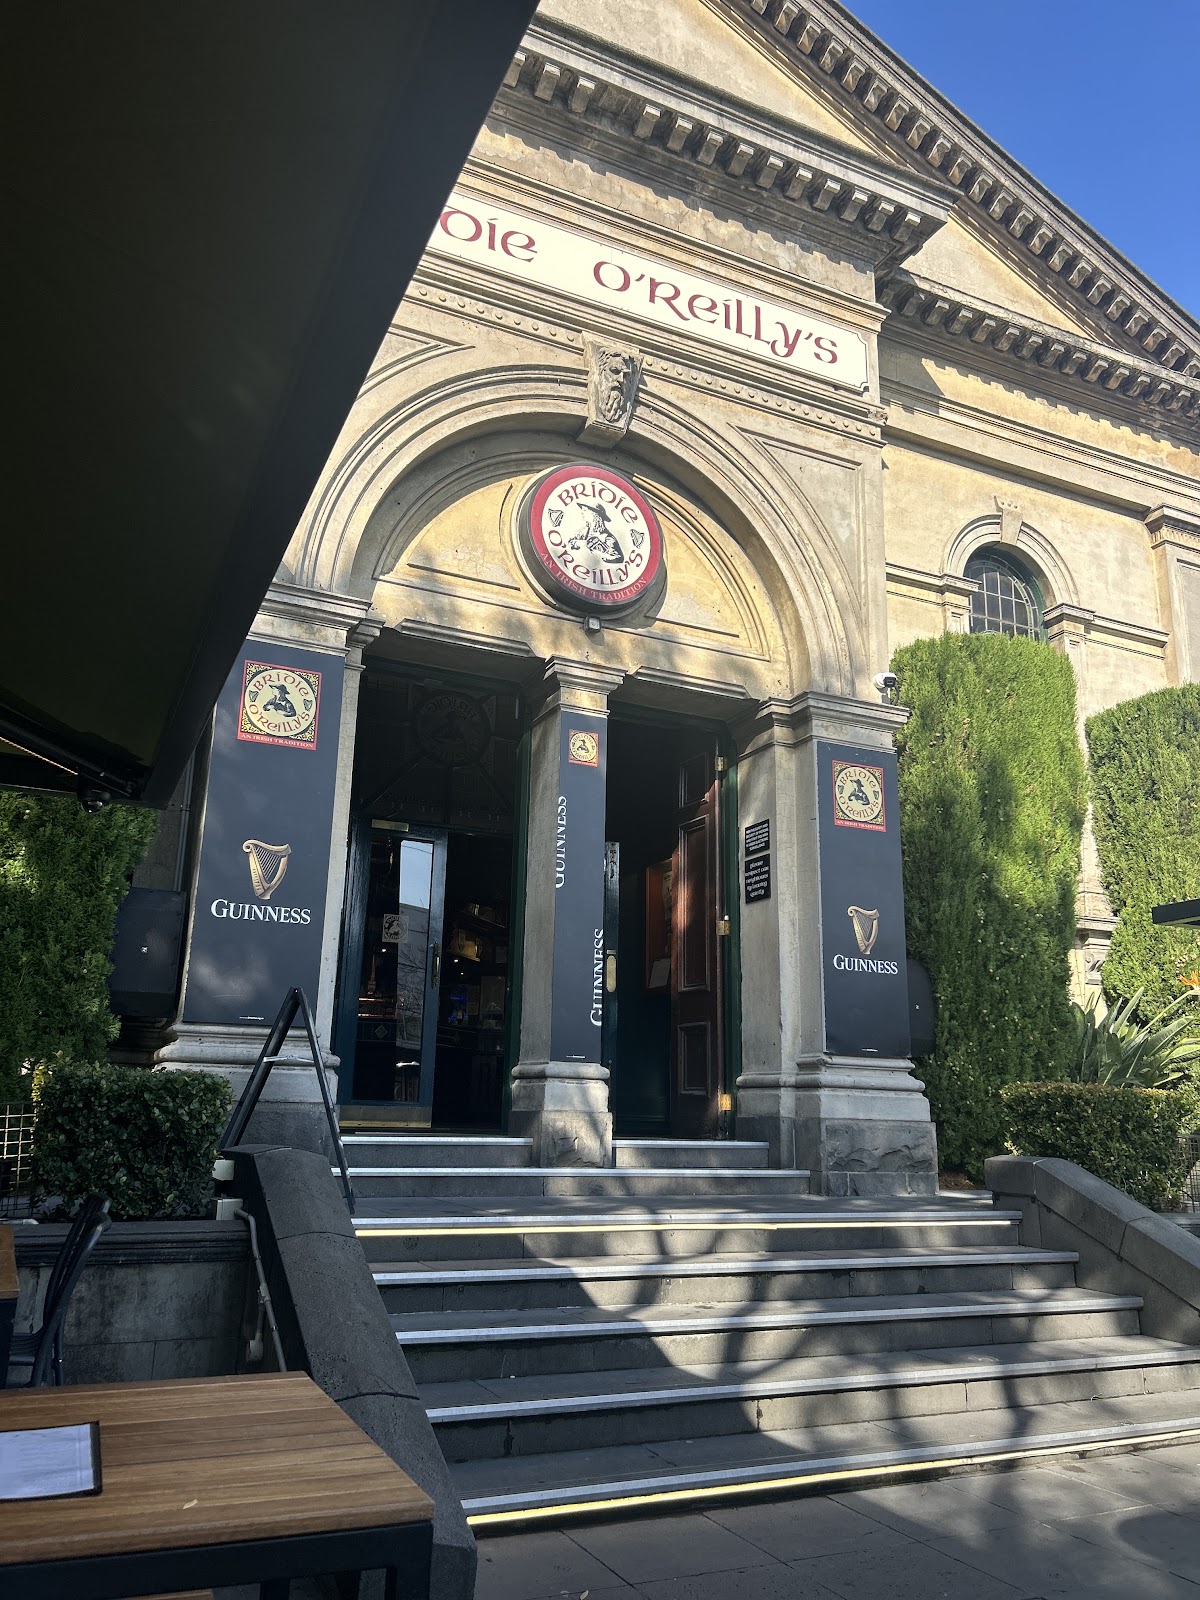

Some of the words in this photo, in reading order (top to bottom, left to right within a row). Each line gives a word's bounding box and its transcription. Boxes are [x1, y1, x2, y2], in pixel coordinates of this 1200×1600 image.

[440, 205, 538, 263] die
[541, 552, 555, 569] AN
[556, 571, 587, 595] IRISH
[591, 577, 647, 600] TRADITION
[275, 738, 313, 748] TRADITION
[556, 796, 567, 888] GUINNESS
[211, 899, 311, 924] GUINNESS
[590, 929, 604, 1027] GUINNESS
[833, 954, 898, 975] GUINNESS
